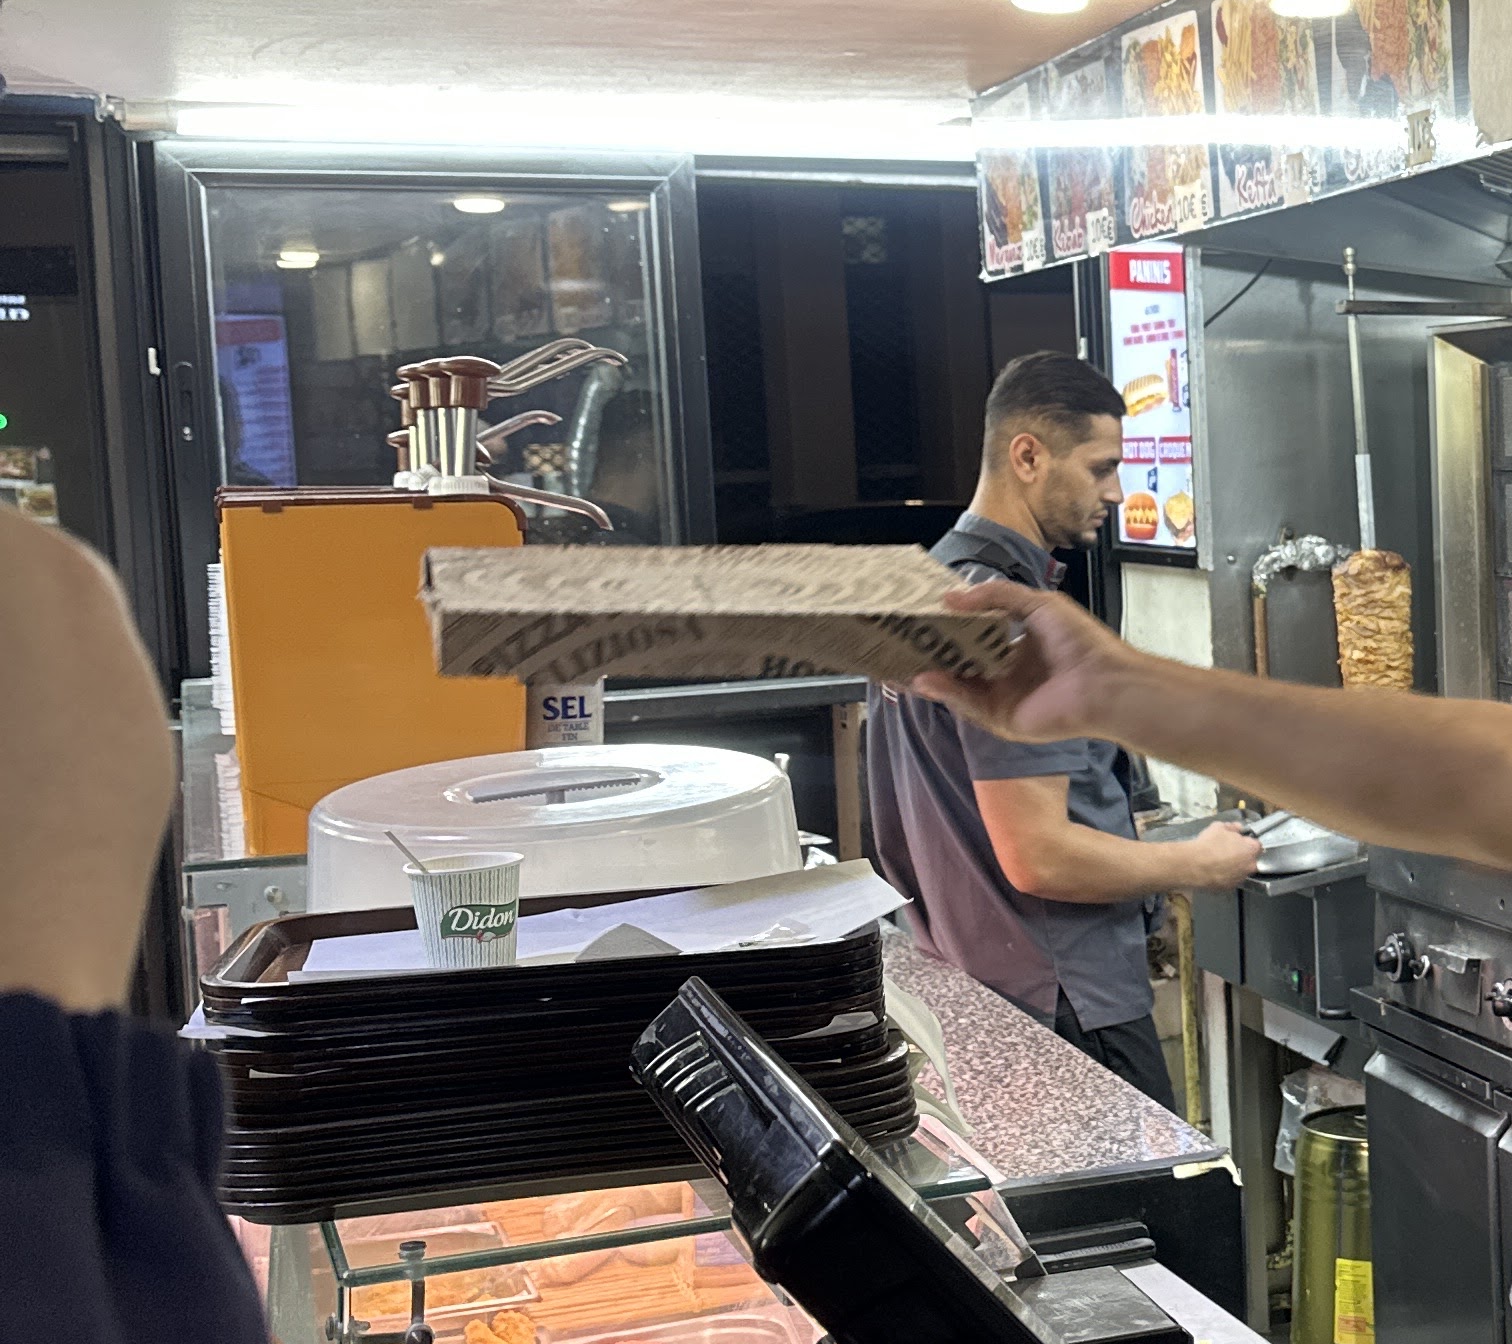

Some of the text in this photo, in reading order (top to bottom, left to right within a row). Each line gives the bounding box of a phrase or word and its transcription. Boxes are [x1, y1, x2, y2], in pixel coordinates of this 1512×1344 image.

[1128, 259, 1171, 284] PANINIS
[542, 696, 593, 721] SEL
[449, 907, 514, 931] Didon
